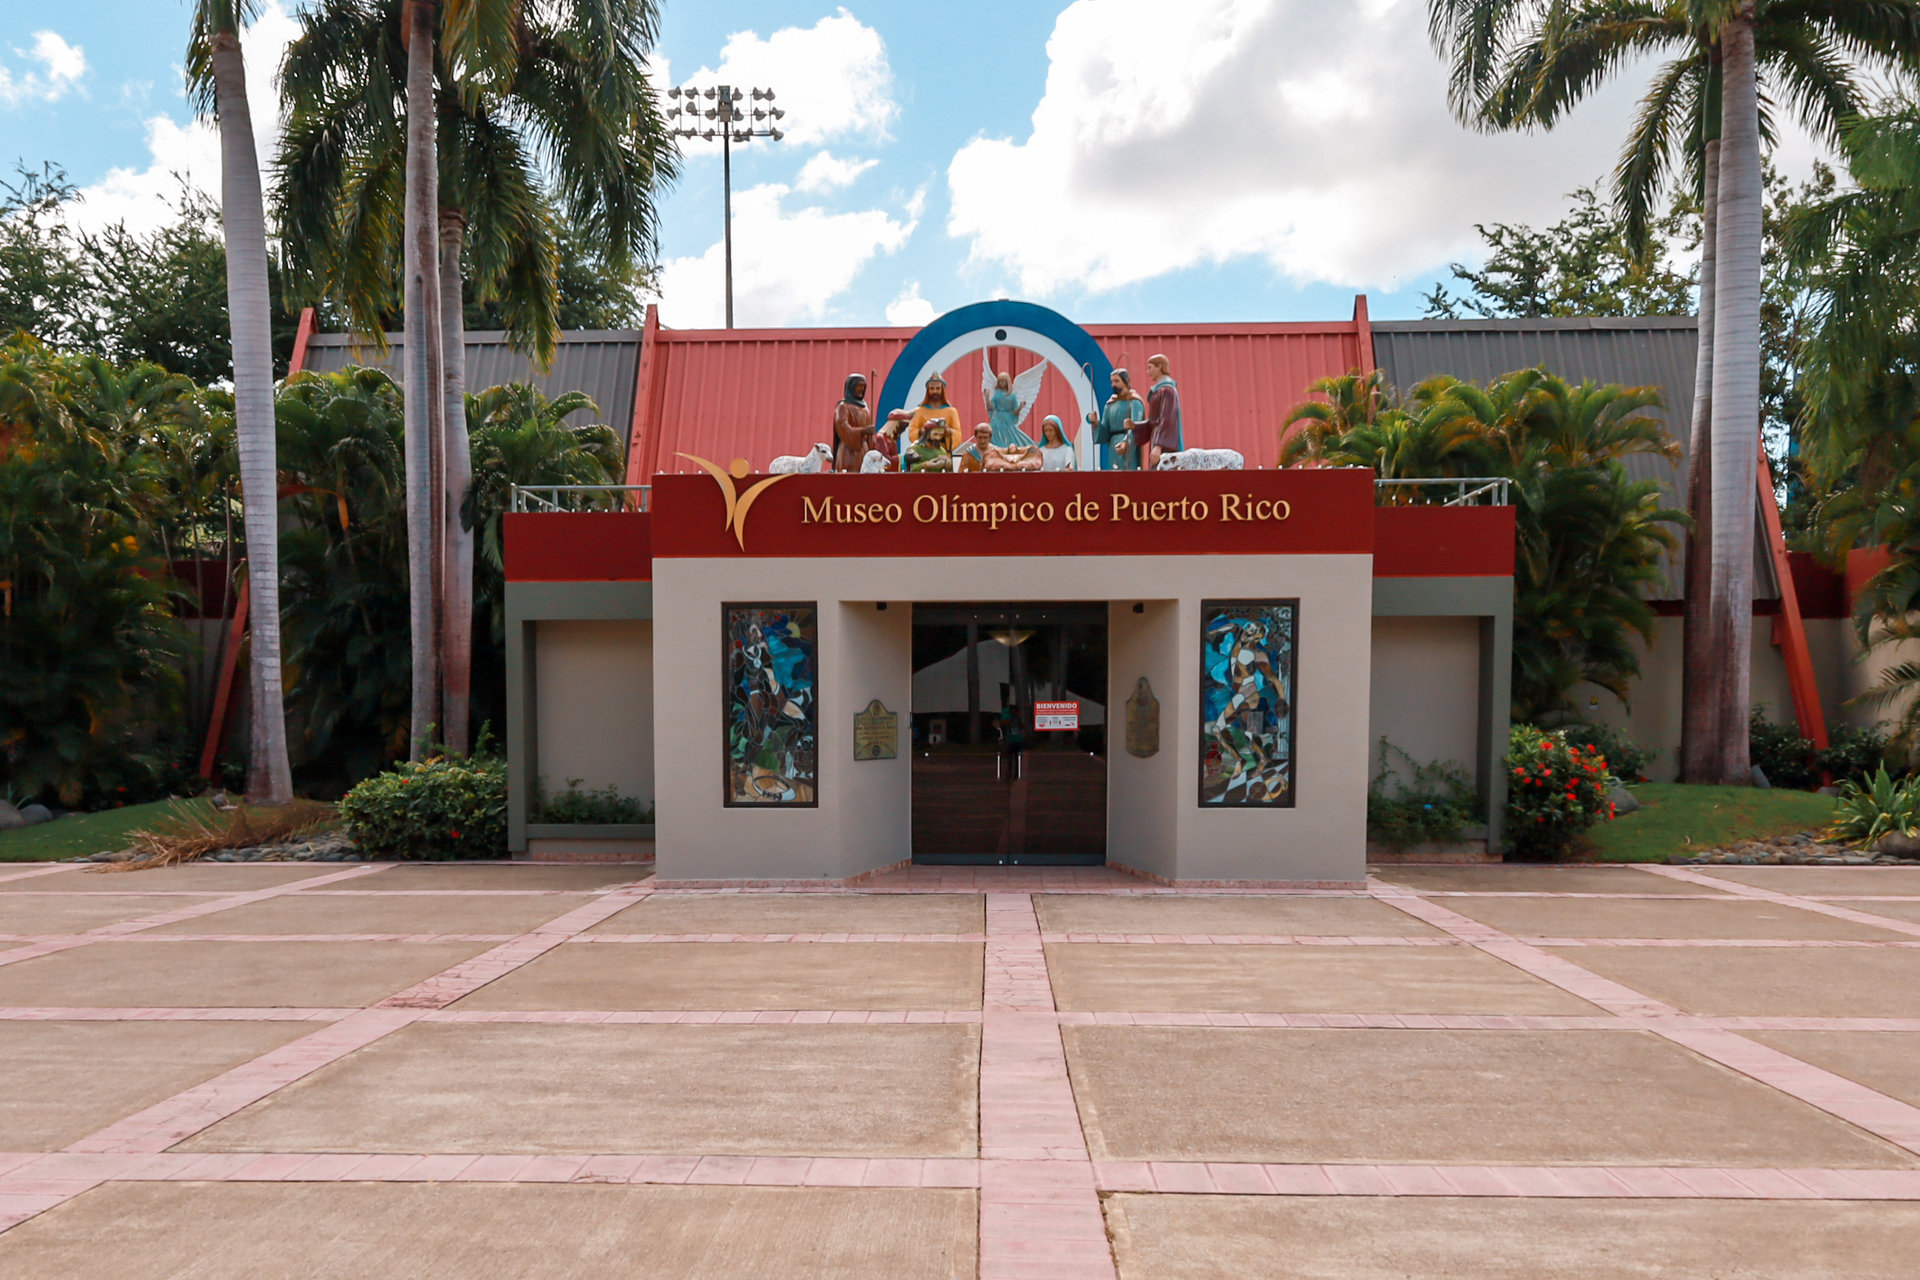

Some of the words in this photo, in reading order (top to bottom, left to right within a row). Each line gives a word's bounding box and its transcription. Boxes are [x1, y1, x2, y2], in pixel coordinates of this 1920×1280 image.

[801, 496, 903, 524] Museo
[912, 494, 1055, 531] Olímpico
[1064, 494, 1100, 523] de
[1109, 494, 1209, 523] Puerto
[1219, 493, 1291, 522] Rico
